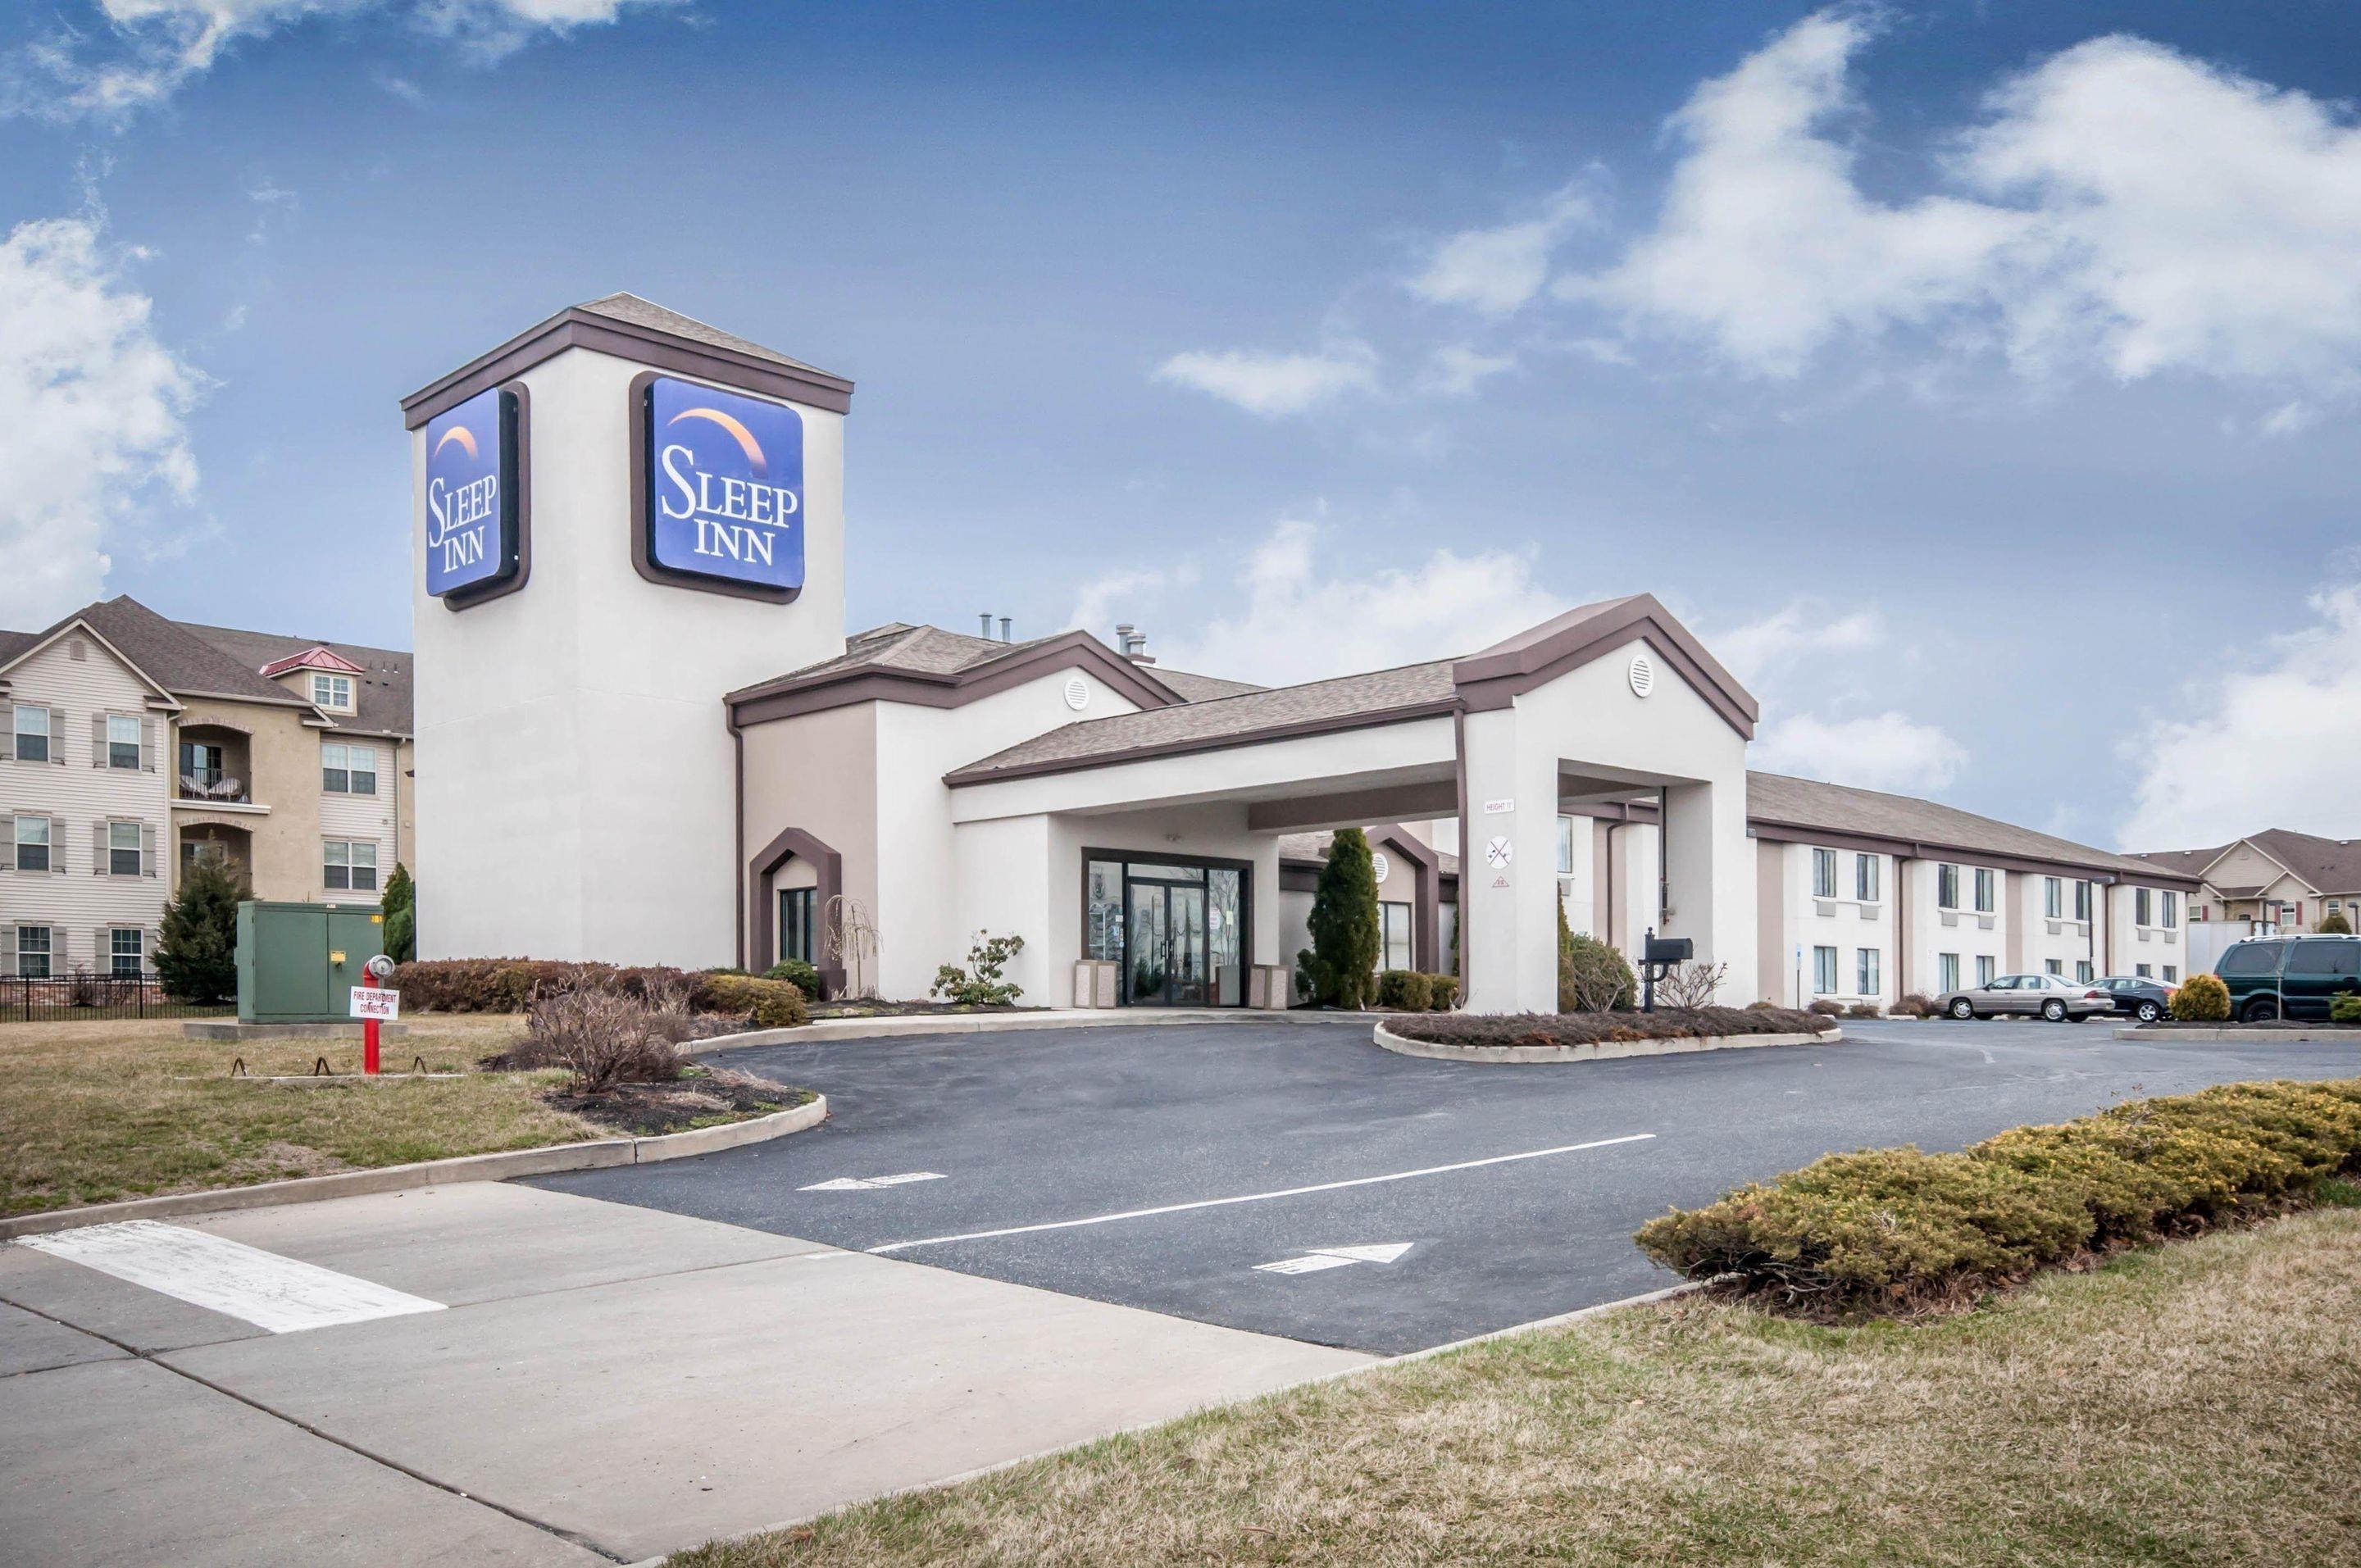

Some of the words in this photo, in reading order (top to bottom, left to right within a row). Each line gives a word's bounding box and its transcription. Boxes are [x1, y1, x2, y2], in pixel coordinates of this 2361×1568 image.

[662, 444, 798, 529] SLEEP
[429, 475, 497, 548] SLEEP
[444, 525, 484, 574] INN
[694, 518, 776, 566] INN
[354, 991, 365, 1001] FIRE
